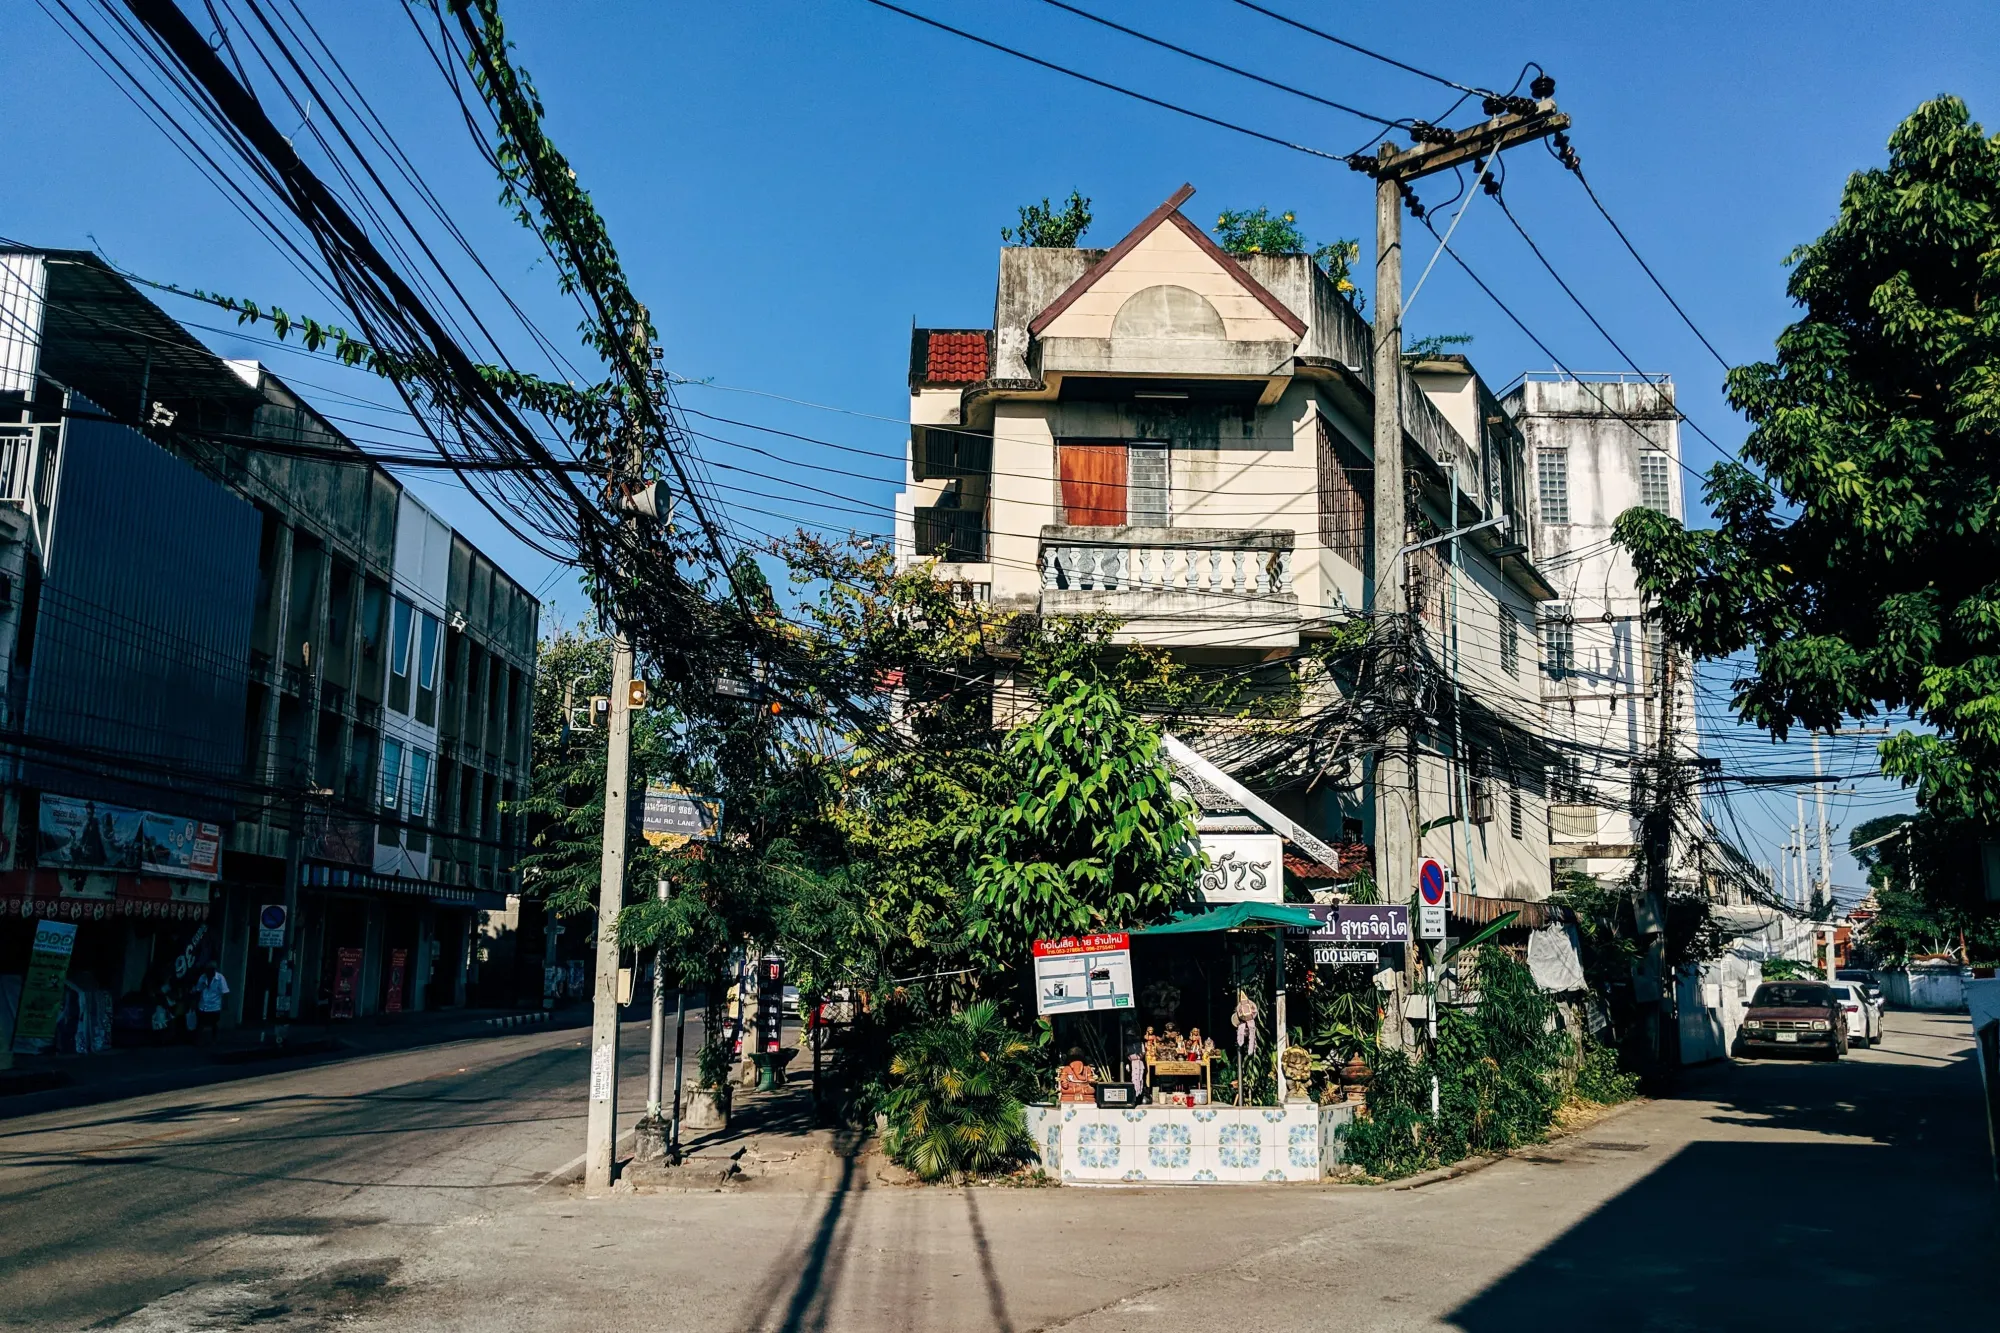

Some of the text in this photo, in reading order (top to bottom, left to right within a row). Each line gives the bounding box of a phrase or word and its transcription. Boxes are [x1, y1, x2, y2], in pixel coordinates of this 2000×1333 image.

[677, 819, 695, 827] LANE
[1195, 850, 1272, 891] สาร
[1315, 950, 1367, 962] 100 เมตร
